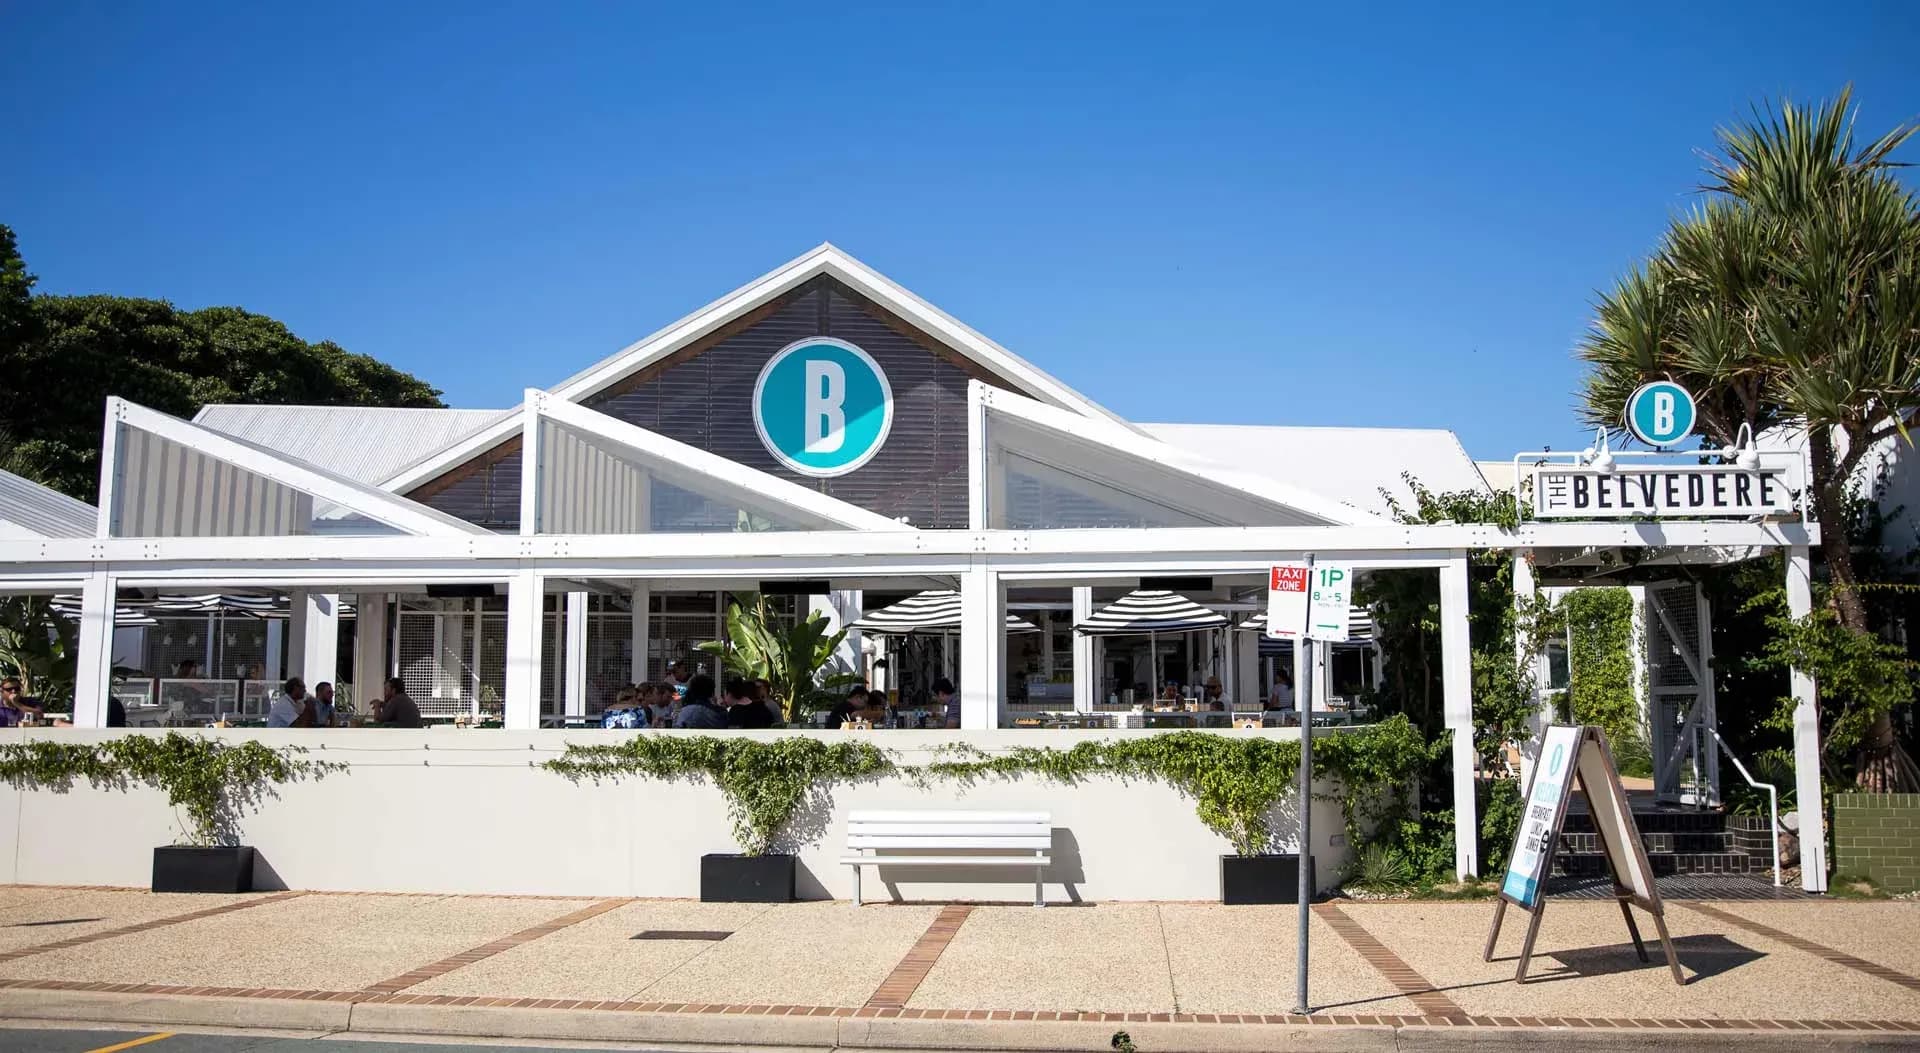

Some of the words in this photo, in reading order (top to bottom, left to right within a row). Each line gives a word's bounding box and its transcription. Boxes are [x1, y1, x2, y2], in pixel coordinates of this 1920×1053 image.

[805, 359, 846, 454] B
[1653, 391, 1675, 436] B
[1549, 474, 1567, 509] THE
[1573, 472, 1775, 509] BELVEDERE
[1276, 568, 1303, 580] TAXI
[1320, 569, 1344, 587] 1P
[1276, 580, 1301, 591] ZONE
[1531, 805, 1553, 822] BREAKFAST
[1530, 821, 1544, 836] LUNCH
[1525, 835, 1540, 852] DINNER
